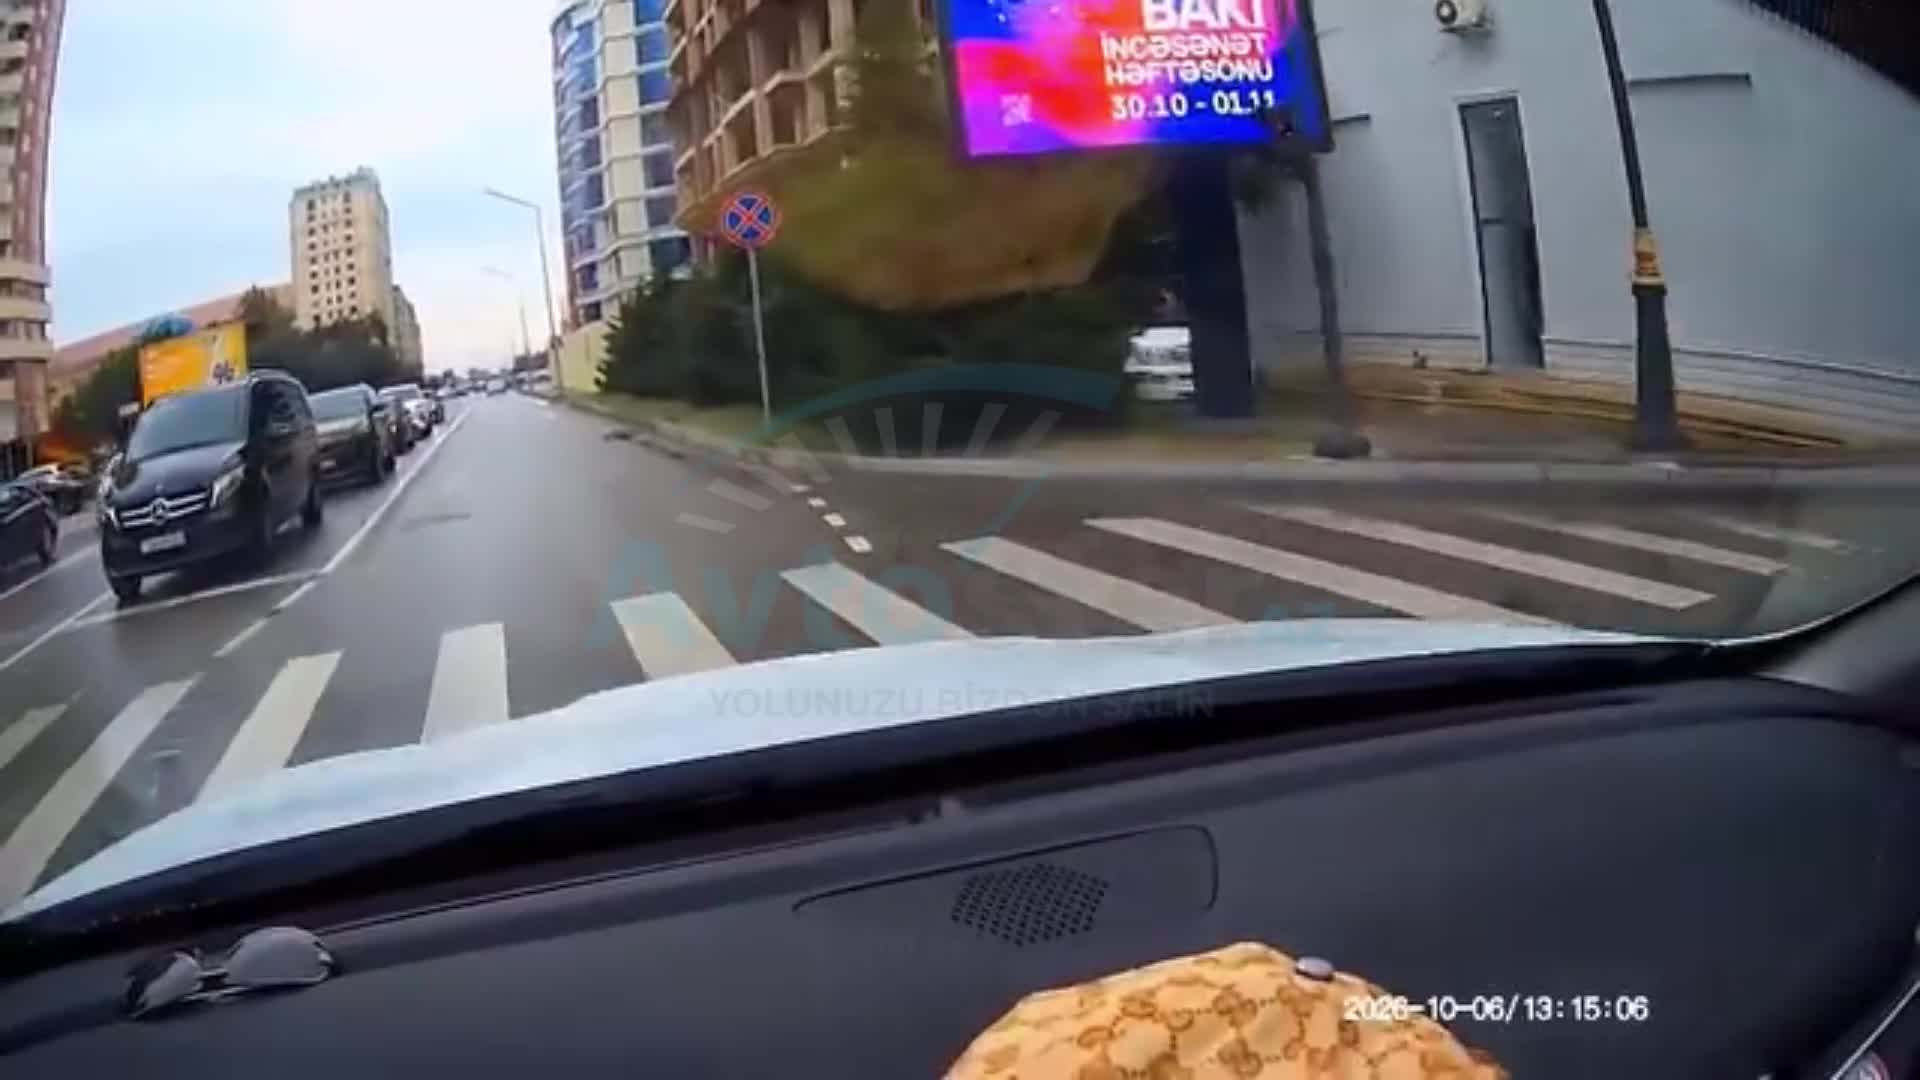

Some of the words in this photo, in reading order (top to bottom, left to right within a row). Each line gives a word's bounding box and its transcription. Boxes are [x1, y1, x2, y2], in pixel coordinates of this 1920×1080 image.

[1143, 0, 1265, 31] BAKI
[1099, 31, 1267, 60] İNCƏSƏNƏT
[1105, 56, 1273, 86] HƏFTƏSONU
[1112, 92, 1189, 120] 30.10
